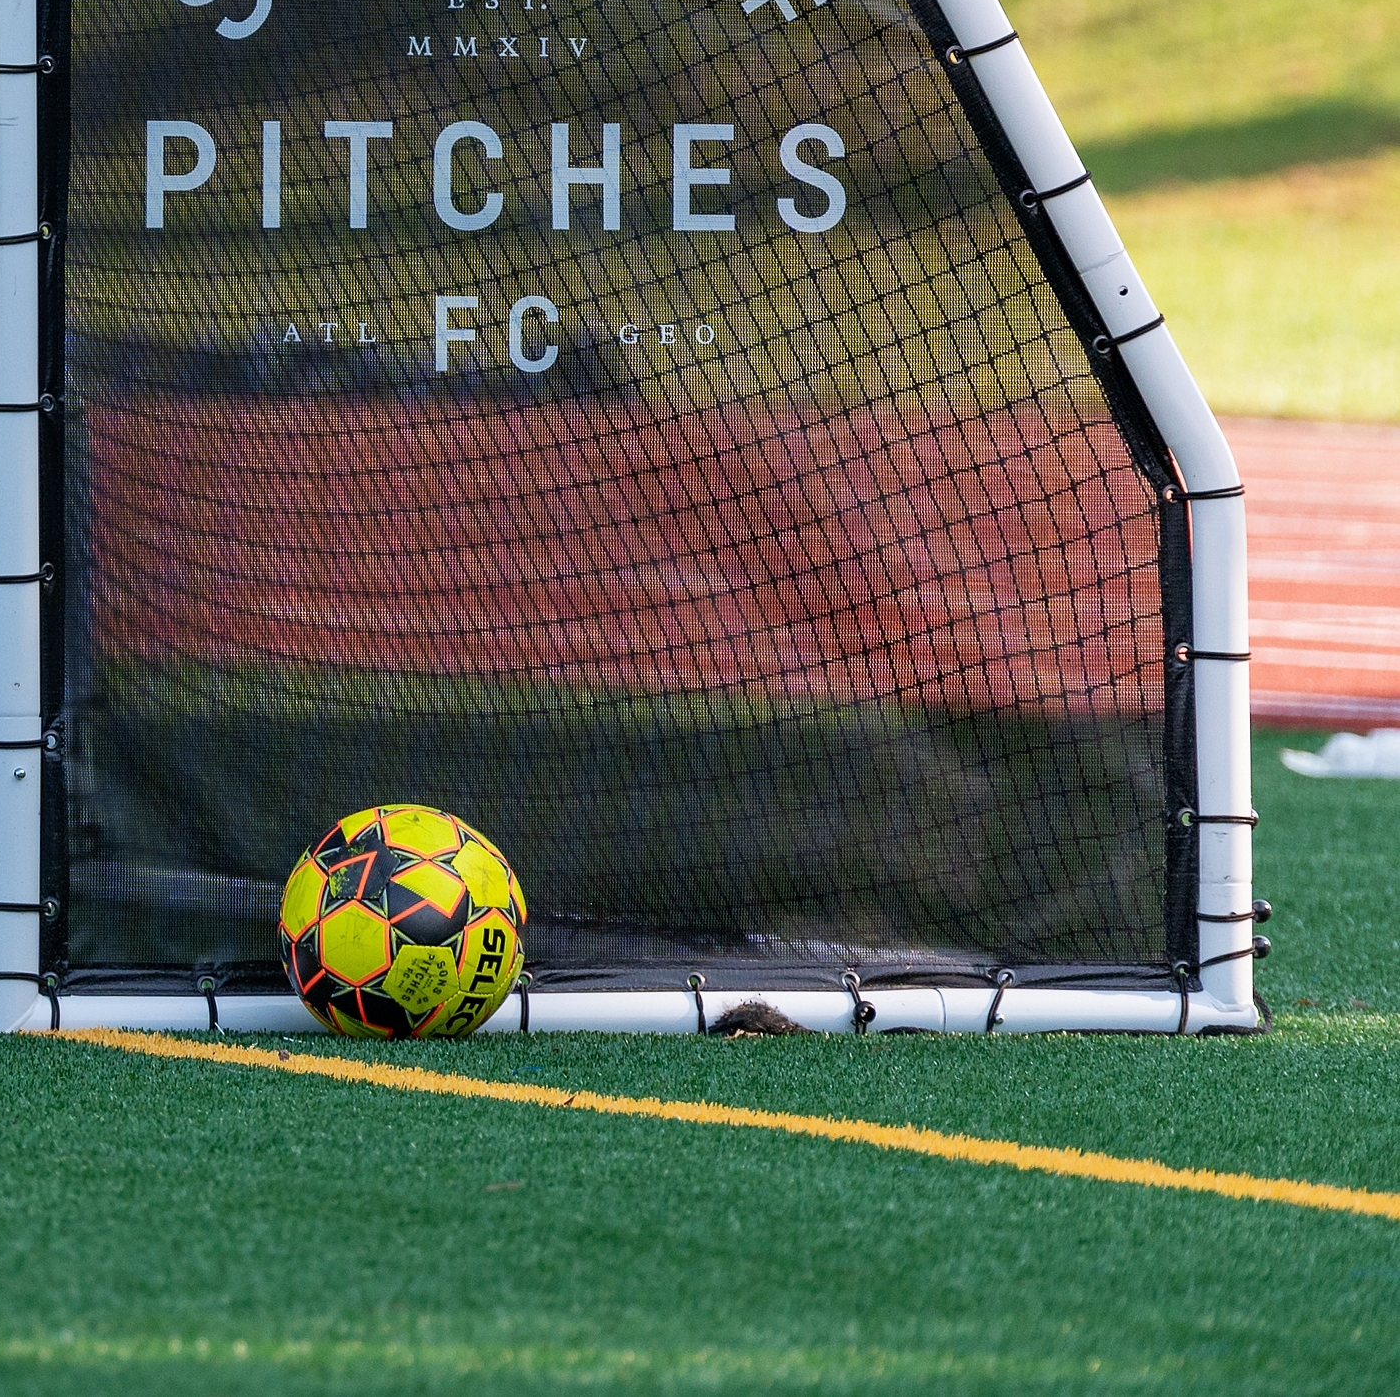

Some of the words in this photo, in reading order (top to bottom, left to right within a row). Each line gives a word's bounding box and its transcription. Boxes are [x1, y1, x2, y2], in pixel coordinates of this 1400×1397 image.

[407, 36, 588, 58] MMXIV
[145, 119, 847, 234] PITCHES
[283, 322, 377, 343] ATL
[435, 295, 559, 373] FC
[619, 323, 716, 345] GEO
[401, 953, 436, 1002] PITCHES
[432, 960, 449, 995] SONS
